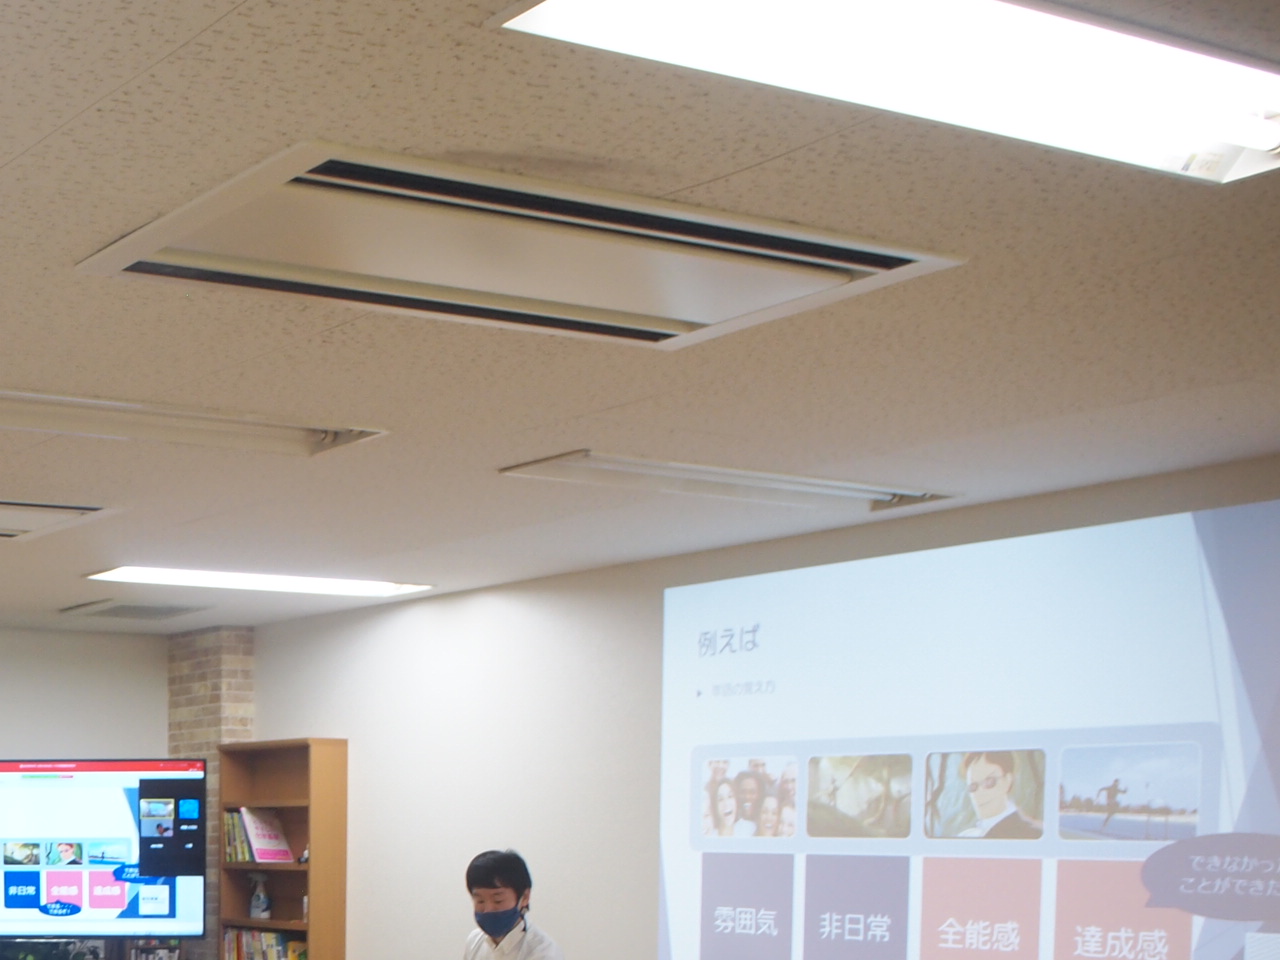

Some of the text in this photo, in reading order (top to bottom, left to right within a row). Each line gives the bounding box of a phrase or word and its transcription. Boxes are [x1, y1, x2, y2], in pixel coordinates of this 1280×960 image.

[697, 622, 761, 658] 例えば
[1189, 855, 1280, 873] できなかっ
[713, 906, 779, 937] 雰囲気
[819, 911, 892, 942] 非日常
[937, 917, 1021, 951] 全能感
[1073, 925, 1169, 960] 達成感
